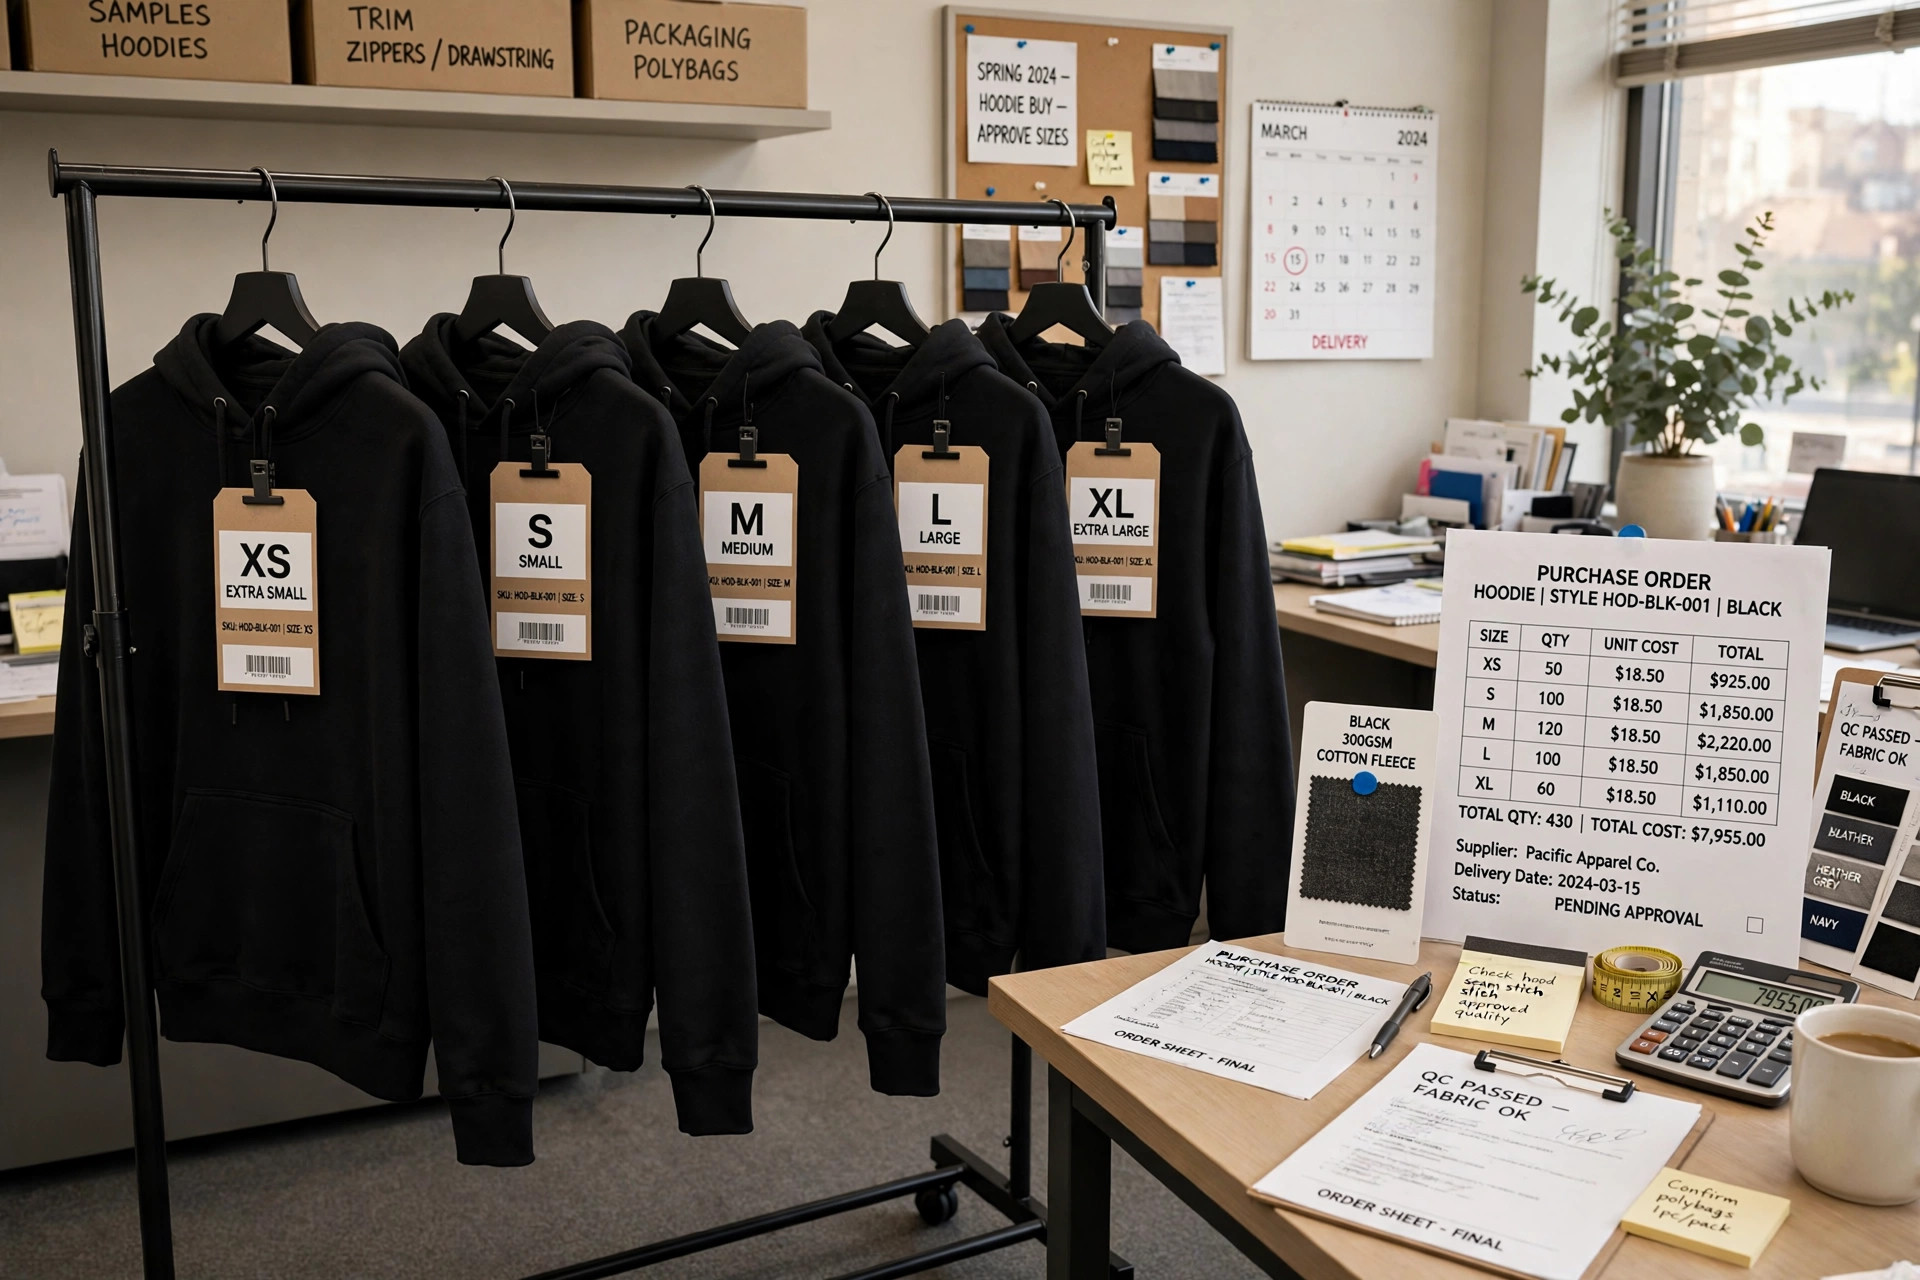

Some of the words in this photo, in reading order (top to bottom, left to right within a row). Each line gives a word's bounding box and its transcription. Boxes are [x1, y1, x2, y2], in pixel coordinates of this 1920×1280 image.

[89, 0, 210, 26] SAMPLES
[348, 6, 413, 31] TRIM
[102, 33, 208, 59] HOODIES
[625, 19, 751, 50] PACKAGING
[347, 41, 426, 64] ZIPPERS
[448, 44, 554, 70] DRAWSTRING
[634, 54, 739, 82] POLYBAGS
[978, 62, 1022, 83] SPRING
[1028, 66, 1057, 85] 2024
[979, 93, 1024, 113] HOODIE
[1030, 96, 1053, 115] BUY
[978, 124, 1031, 145] APPROVE
[1037, 128, 1069, 146] SIZES
[1261, 123, 1307, 140] MARCH
[1398, 130, 1428, 147] 2024
[1290, 254, 1300, 265] 15
[1290, 282, 1301, 292] 24
[1314, 282, 1325, 293] 25
[1312, 335, 1368, 350] DELIVERY
[932, 494, 952, 525] L
[1088, 488, 1134, 519] XL
[731, 502, 763, 536] M
[1074, 524, 1109, 536] EXTRA
[1112, 525, 1149, 538] LARGE
[528, 514, 553, 549] S
[920, 530, 961, 545] LARGE
[240, 543, 290, 578] XS
[722, 541, 773, 556] MEDIUM
[519, 554, 562, 569] SMALL
[977, 568, 981, 576] L
[1145, 558, 1153, 566] XL
[784, 579, 791, 588] M
[1538, 564, 1639, 587] PURCHASE
[1644, 570, 1712, 591] ORDER
[226, 584, 264, 599] EXTRA
[267, 586, 307, 600] SMALL
[496, 590, 513, 600] SKU:
[580, 594, 585, 603] S
[1474, 584, 1536, 602] HOODIE
[1550, 588, 1598, 606] STYLE
[1602, 592, 1710, 613] HOD-BLK-001
[1727, 599, 1782, 617] BLACK
[222, 621, 237, 631] SKU:
[304, 624, 313, 634] XS
[1480, 628, 1509, 644] SIZE
[1542, 633, 1569, 649] QTY
[1604, 637, 1637, 652] UNIT
[1642, 640, 1679, 655] COST
[1718, 645, 1764, 661] TOTAL
[1483, 657, 1501, 672] XS
[1544, 661, 1563, 677] 50
[1615, 665, 1665, 684] $18.50
[1710, 672, 1770, 692] $925.00
[1486, 687, 1495, 702] S
[1538, 691, 1564, 706] 100
[1612, 696, 1663, 714] $18.50
[1700, 702, 1774, 723] $1,850.00
[1350, 715, 1390, 731] BLACK
[1482, 716, 1495, 731] M
[1538, 721, 1563, 737] 120
[1610, 726, 1661, 744] $18.50
[1697, 732, 1772, 753] $2,220.00
[1841, 722, 1860, 737] QC
[1862, 726, 1911, 745] PASSED
[1342, 733, 1393, 749] 300GSM
[1317, 749, 1368, 766] COTTON
[1371, 754, 1416, 770] FLEECE
[1483, 747, 1490, 761] L
[1534, 751, 1561, 767] 100
[1608, 756, 1659, 775] $18.50
[1694, 764, 1770, 785] $1,850.00
[1840, 743, 1886, 762] FABRIC
[1888, 752, 1909, 767] OK
[1475, 776, 1494, 791] XL
[1537, 781, 1555, 797] 60
[1606, 787, 1656, 806] $18.50
[1692, 794, 1768, 816] $1,110.00
[1840, 790, 1876, 807] BLACK
[1458, 804, 1504, 822] TOTAL
[1508, 808, 1543, 826] QTY:
[1546, 812, 1573, 829] 430
[1591, 817, 1637, 836] TOTAL
[1642, 822, 1686, 840] COST:
[1691, 826, 1766, 848] $7,955.00
[1456, 838, 1518, 859] Supplier:
[1526, 844, 1573, 864] Pacific
[1577, 851, 1632, 872] Apparel
[1636, 858, 1660, 873] Co.
[1454, 862, 1511, 885] Delivery
[1515, 868, 1553, 887] Date:
[1558, 874, 1640, 896] 2024-03-15
[1813, 876, 1840, 890] GREY
[1816, 864, 1861, 883] HEATHER
[1452, 886, 1500, 905] Status:
[1554, 897, 1621, 919] PENDING
[1624, 906, 1704, 929] APPROVAL
[1810, 914, 1839, 930] NAVY
[1216, 950, 1300, 975] PURCHASE
[1303, 970, 1359, 989] ORDER
[1469, 966, 1513, 979] Check
[1522, 972, 1557, 986] hood
[1354, 994, 1391, 1005] BLACK
[1464, 978, 1499, 990] seam
[1506, 984, 1544, 997] stich
[1454, 1010, 1510, 1026] quality
[1458, 1000, 1529, 1014] approved
[1114, 1030, 1161, 1049] ORDER
[1162, 1042, 1206, 1060] SHEET
[1217, 1056, 1256, 1074] FINAL
[1421, 1070, 1454, 1088] QC
[1460, 1079, 1543, 1107] PASSED
[1412, 1084, 1490, 1112] FABRIC
[1498, 1106, 1532, 1122] OK
[1668, 1179, 1738, 1206] Confirm
[1656, 1192, 1733, 1219] polybags
[1318, 1188, 1376, 1213] ORDER
[1380, 1206, 1438, 1232] SHEET
[1451, 1228, 1503, 1252] FINAL
